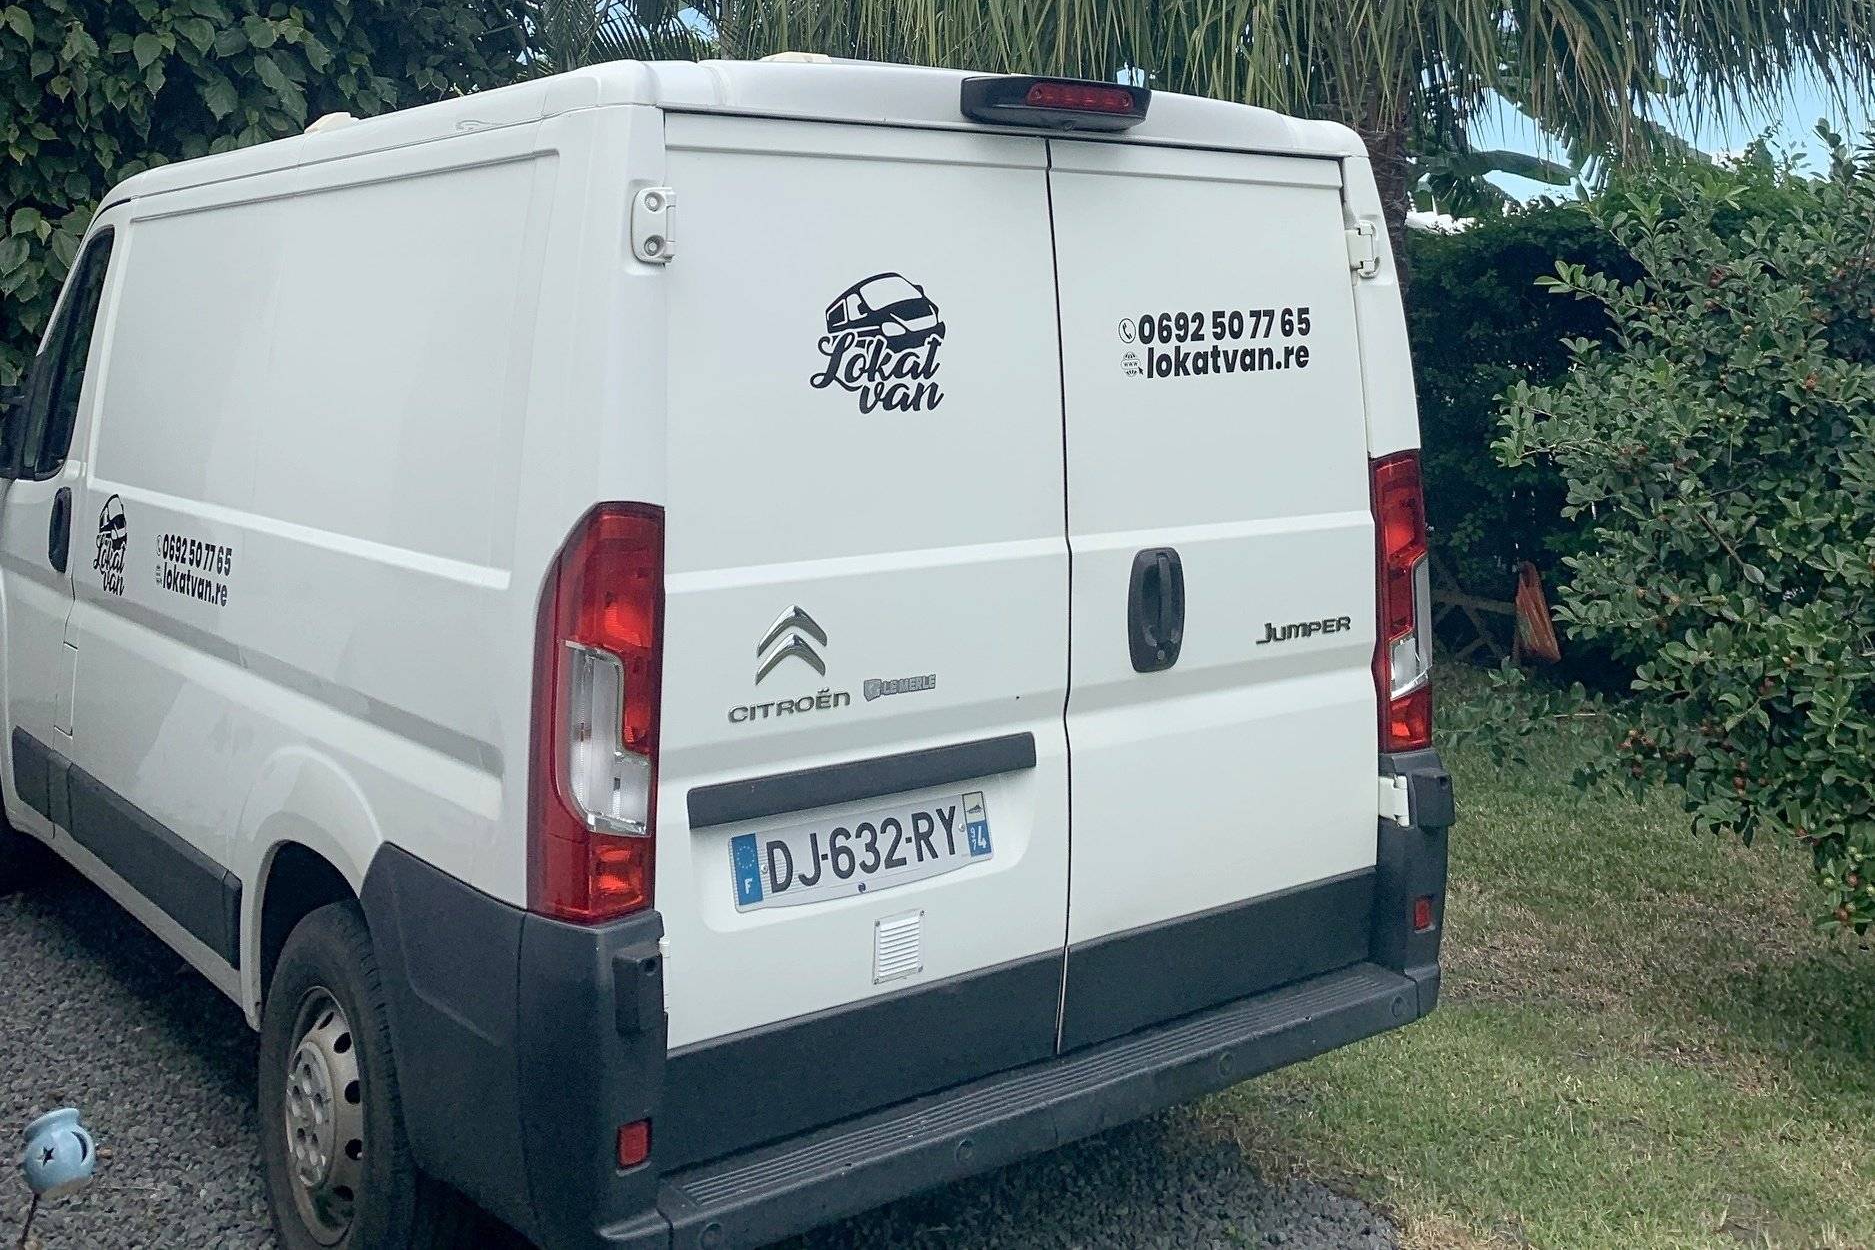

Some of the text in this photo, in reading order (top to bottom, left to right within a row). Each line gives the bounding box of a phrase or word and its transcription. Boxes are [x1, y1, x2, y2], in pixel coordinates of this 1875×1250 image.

[1138, 307, 1311, 344] 0692 50 77 65
[810, 332, 942, 392] Lokat
[1147, 344, 1310, 379] lokatvan.re
[859, 382, 944, 414] van
[93, 534, 126, 574] Lokat
[162, 534, 232, 576] 0692 50 77 65
[102, 569, 125, 596] van
[162, 562, 228, 607] lokatvan.re
[766, 806, 956, 894] DJ-632-RY
[744, 878, 753, 895] F
